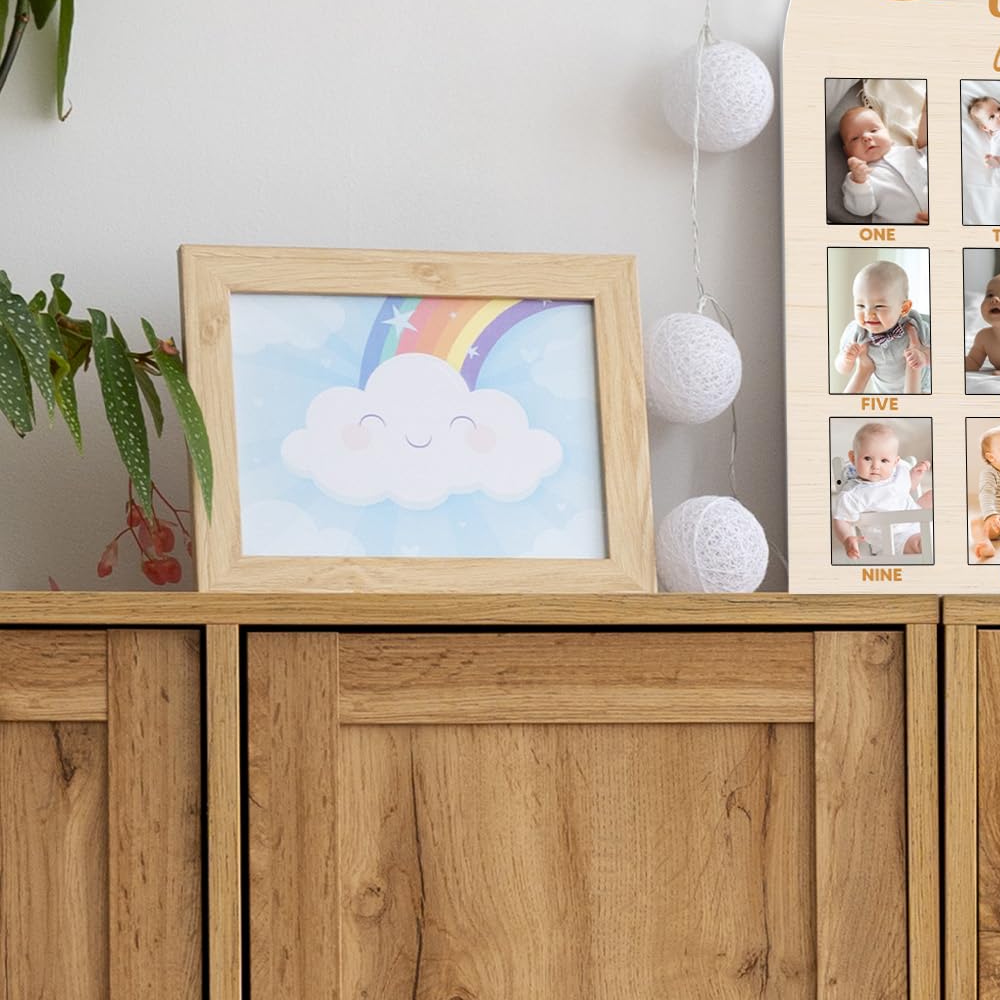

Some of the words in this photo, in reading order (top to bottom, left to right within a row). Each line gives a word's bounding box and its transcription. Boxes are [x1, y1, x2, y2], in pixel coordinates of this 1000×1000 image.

[859, 228, 896, 242] ONE
[861, 397, 898, 411] FIVE
[862, 567, 903, 582] NINE
